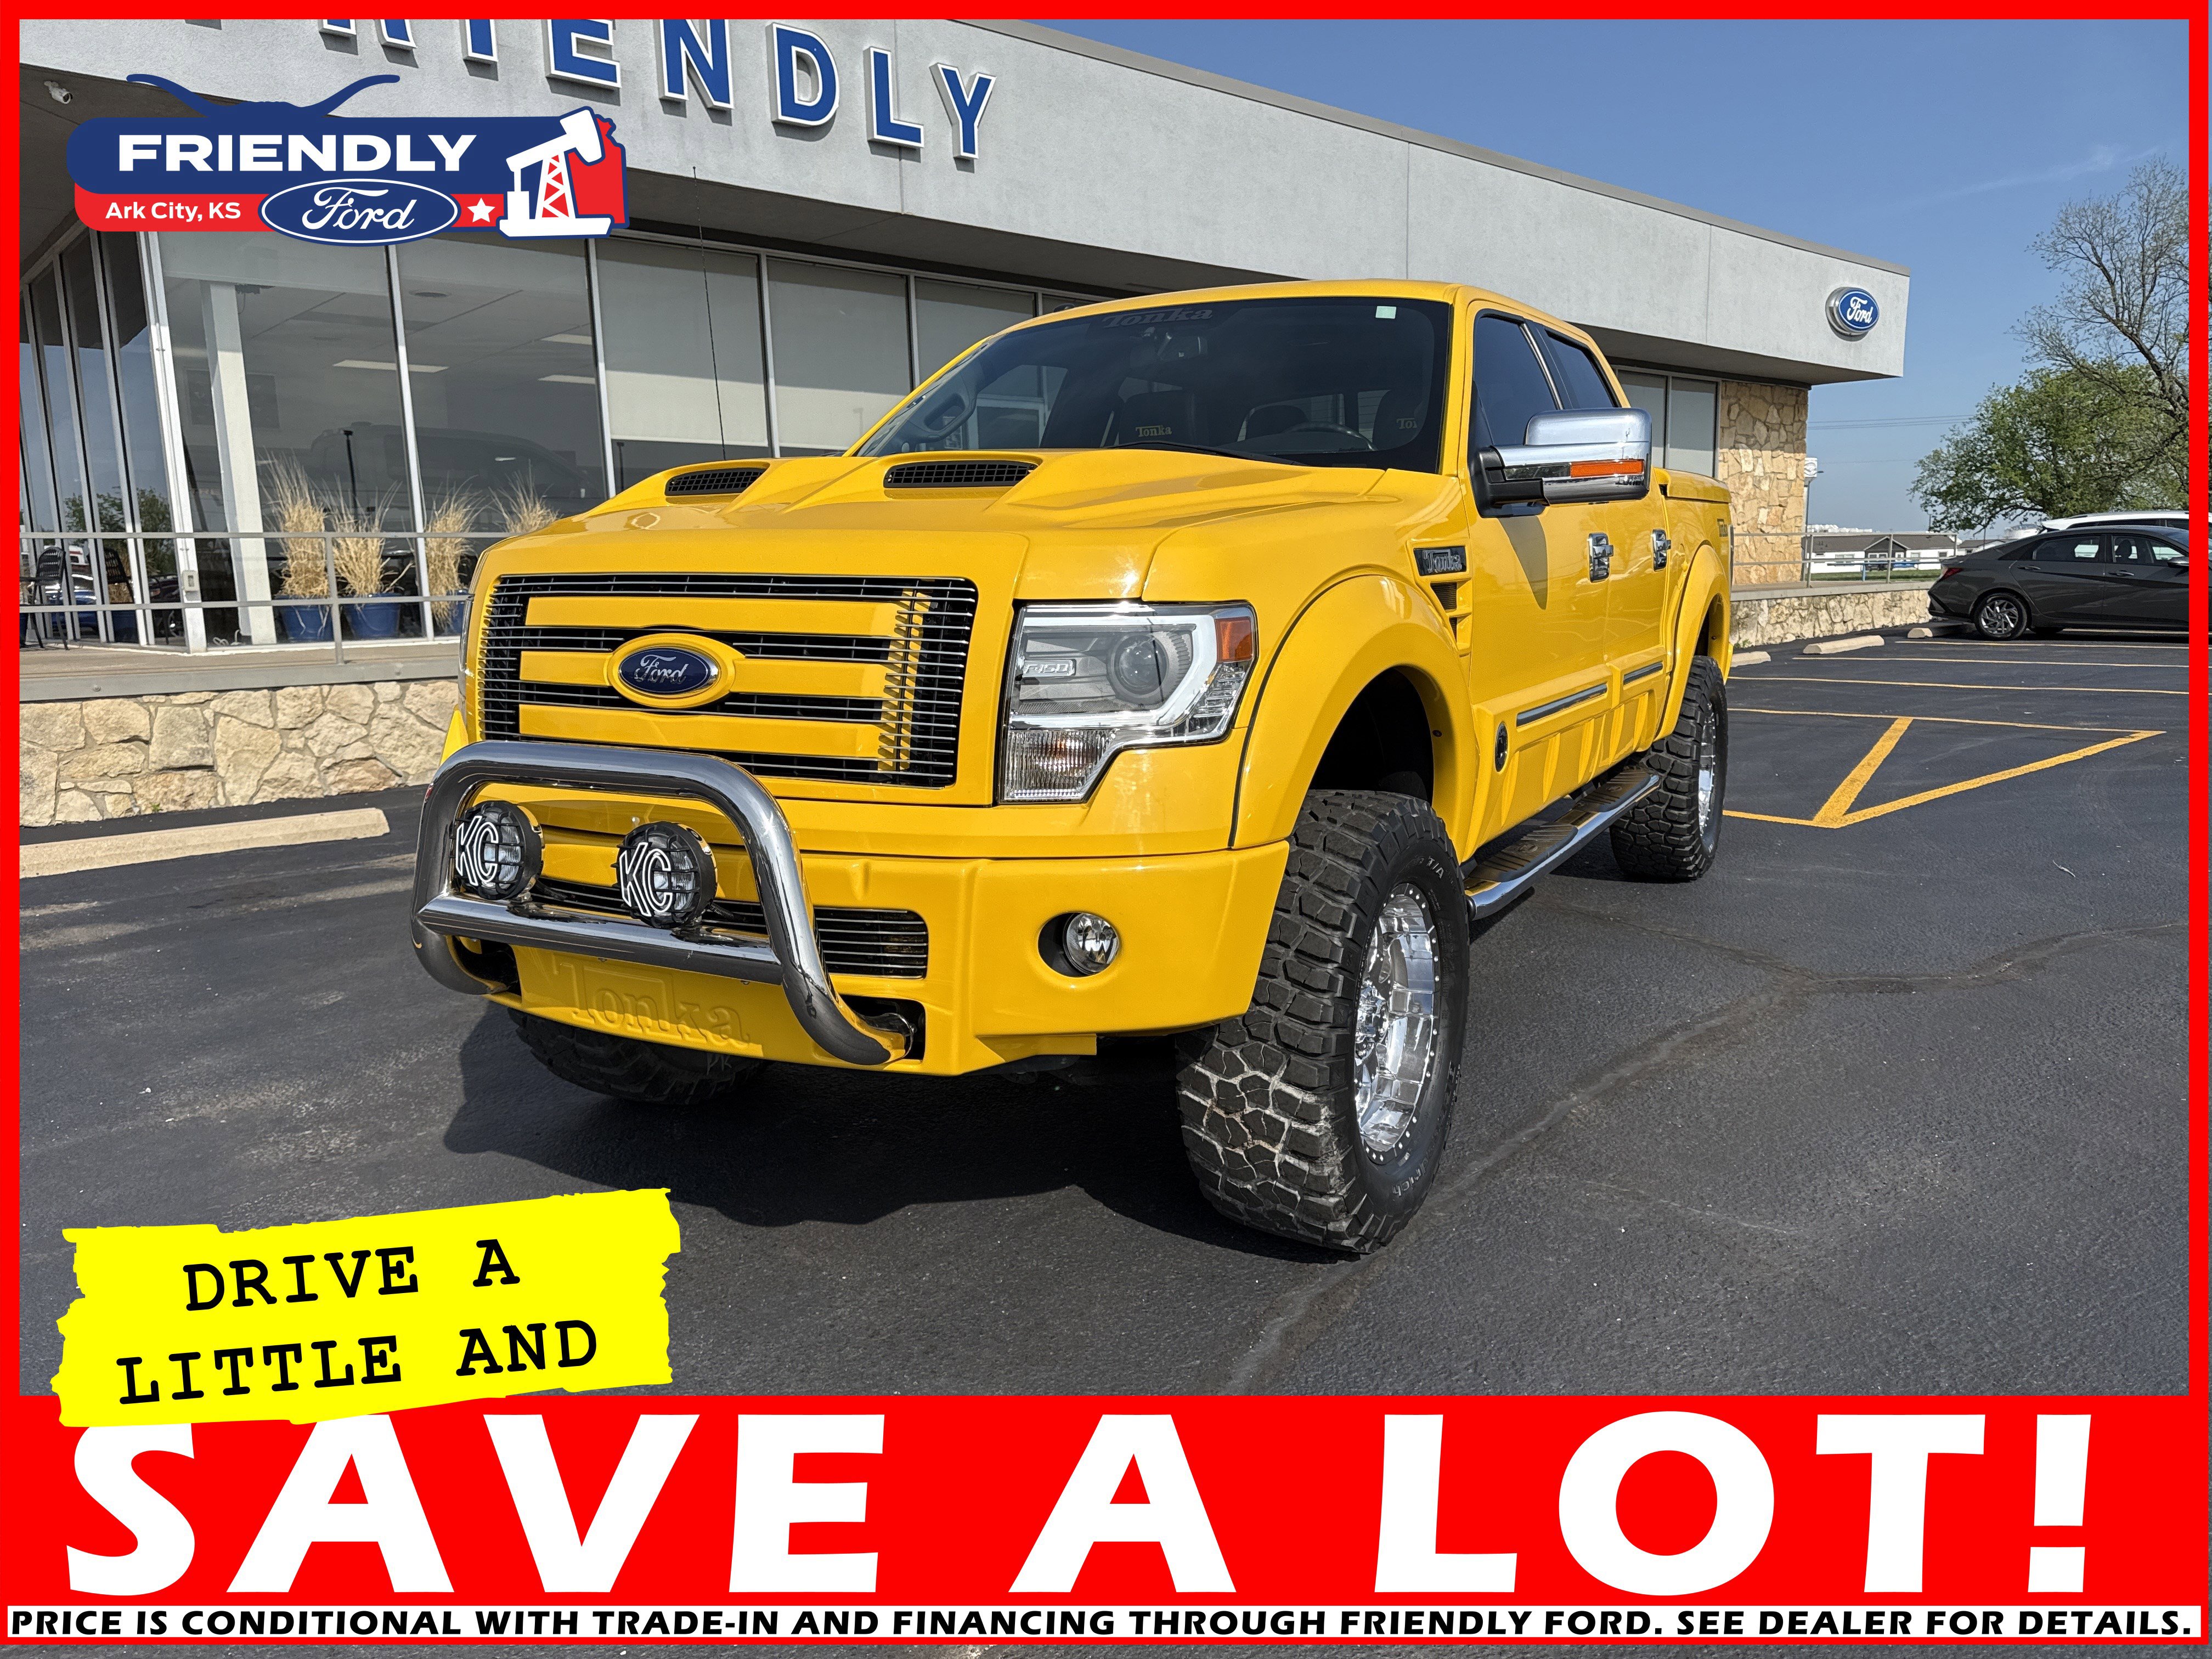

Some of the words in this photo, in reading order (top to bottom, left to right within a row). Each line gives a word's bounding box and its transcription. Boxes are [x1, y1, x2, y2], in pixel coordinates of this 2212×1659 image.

[1102, 308, 1213, 328] Tonka
[1847, 296, 1874, 323] Ford
[1135, 425, 1172, 437] Tonka
[1422, 549, 1462, 573] Tonka
[634, 654, 689, 684] Ford
[455, 815, 499, 887] KC
[619, 842, 673, 917] KC
[551, 958, 751, 1048] Tonka
